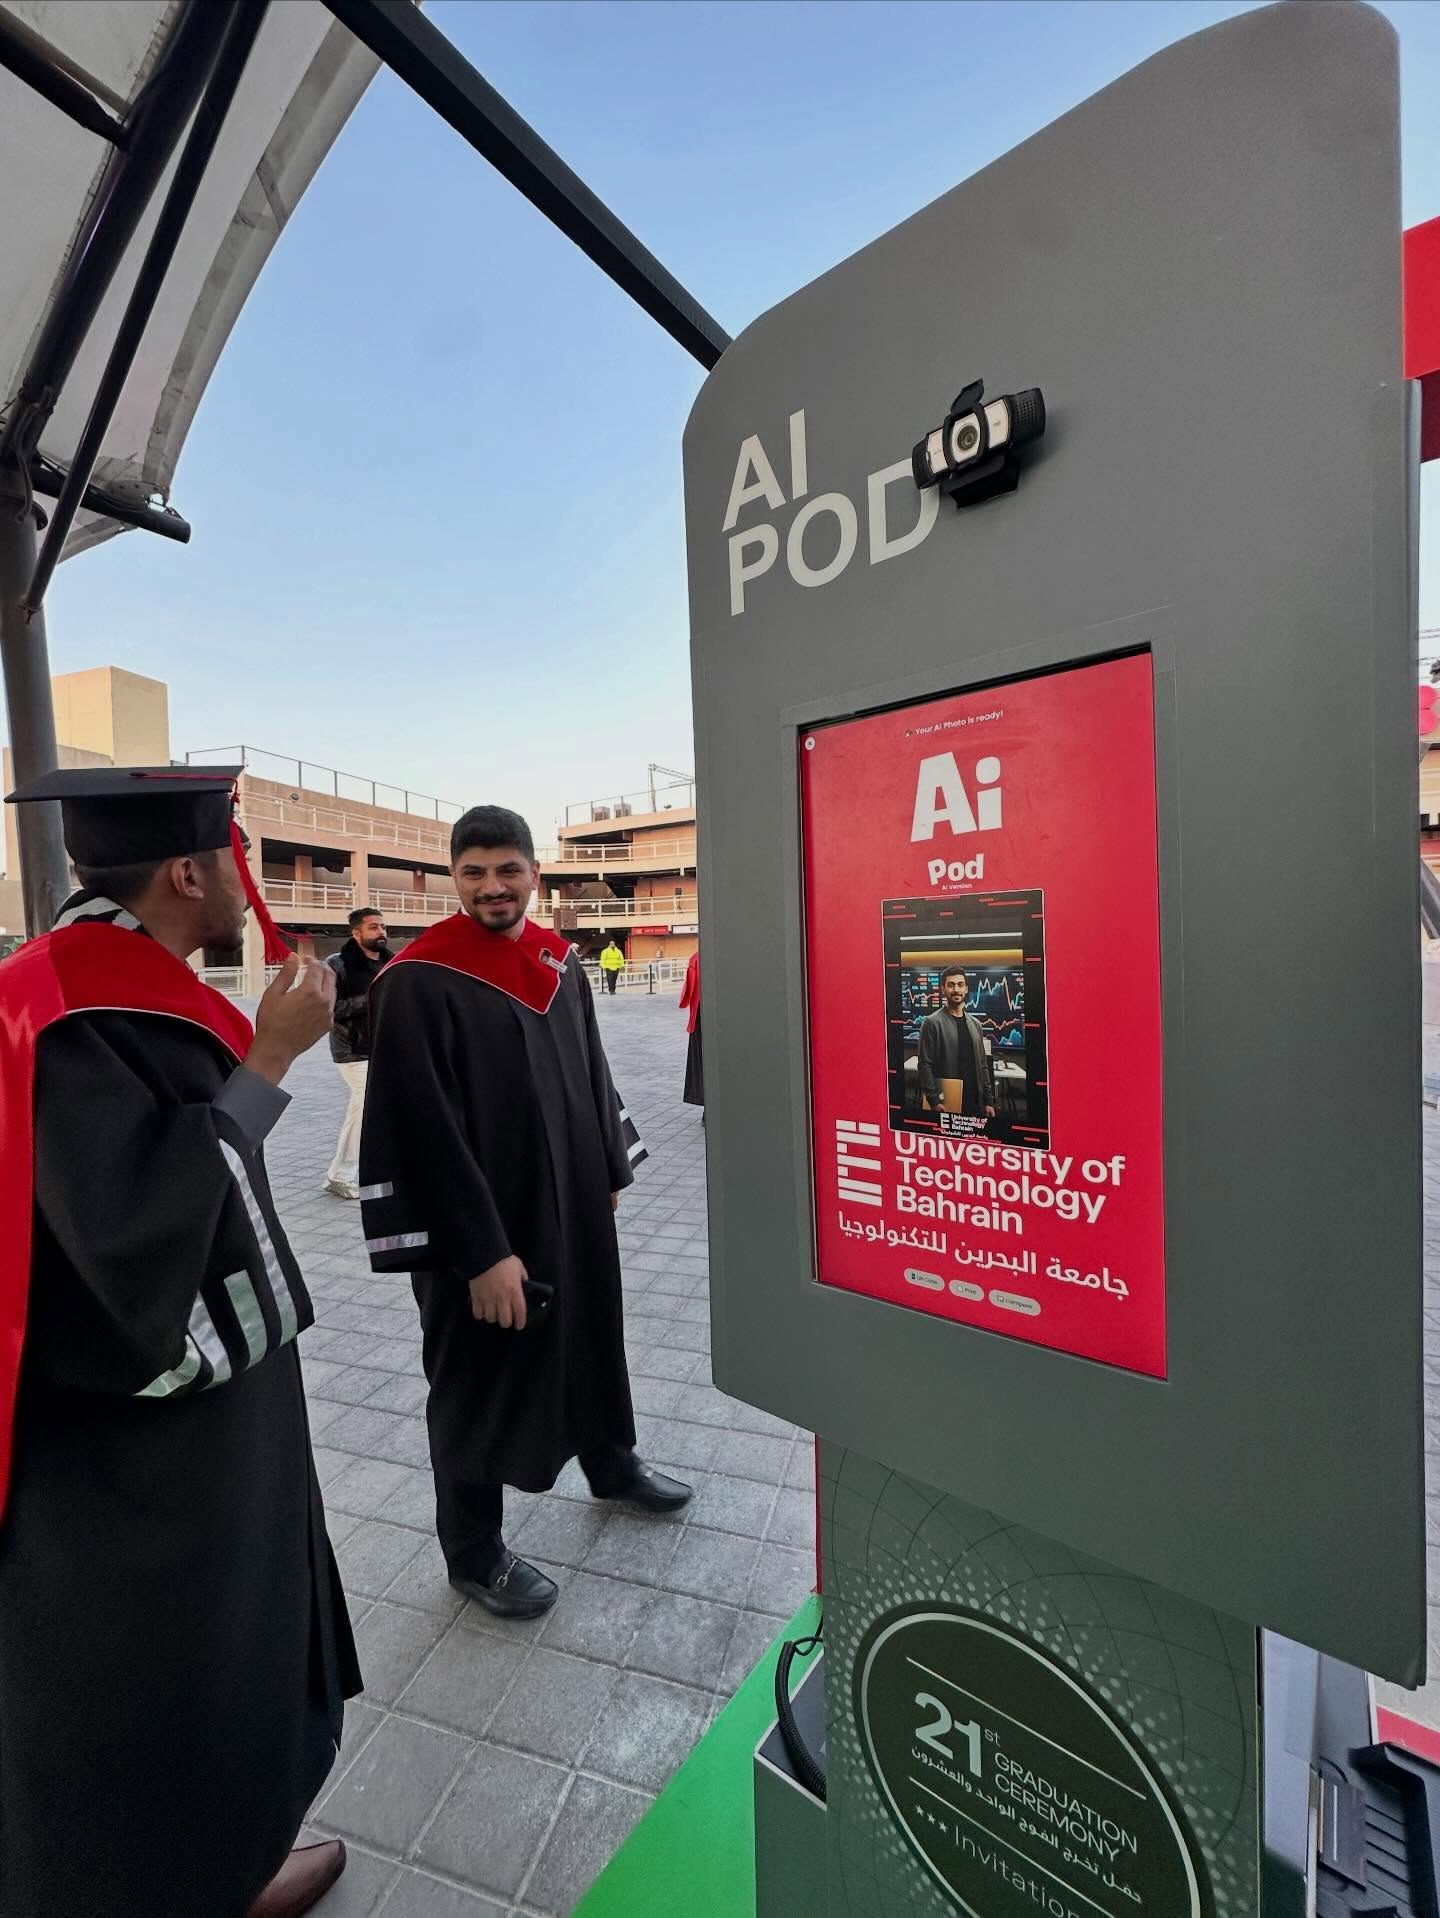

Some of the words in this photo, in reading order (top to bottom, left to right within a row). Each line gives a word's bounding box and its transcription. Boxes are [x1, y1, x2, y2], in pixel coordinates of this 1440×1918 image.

[722, 408, 808, 532] AI
[728, 458, 940, 616] POD
[915, 726, 933, 735] Your
[934, 723, 942, 731] AI
[943, 719, 966, 729] Photo
[967, 716, 975, 724] is
[976, 709, 1004, 723] ready!
[910, 751, 1002, 842] Ai
[928, 853, 984, 886] Pod
[894, 1131, 1073, 1185] University
[1081, 1155, 1126, 1186] of
[895, 1155, 1106, 1224] Technology
[896, 1184, 1023, 1235] Bahrain
[838, 1210, 947, 1254] للتكنولوجيا
[954, 1241, 1037, 1276] البحرين
[1045, 1256, 1130, 1300] جامعة
[911, 1746, 972, 1792] والعشرون
[975, 1788, 1016, 1820] الواحد
[994, 1752, 1137, 1854] GRADUATION
[995, 1773, 1120, 1862] CEREMONY
[1019, 1817, 1059, 1849] الفوج
[1063, 1847, 1099, 1875] تخرج
[1102, 1871, 1143, 1905] حفل
